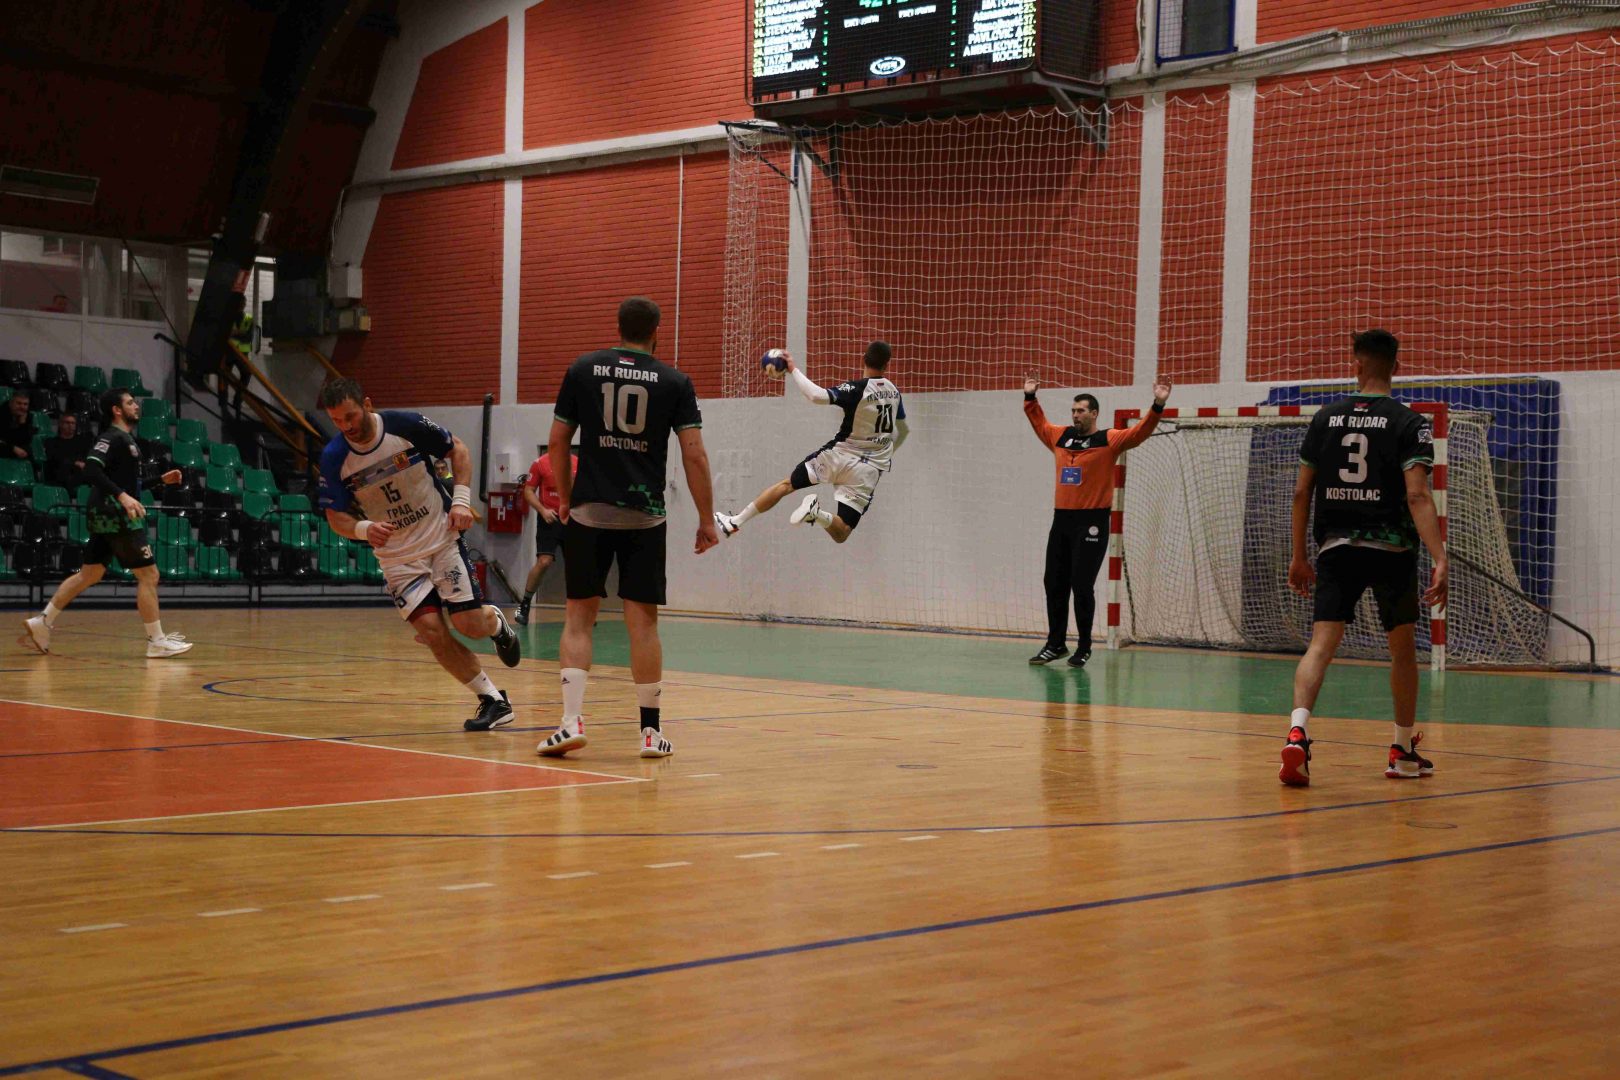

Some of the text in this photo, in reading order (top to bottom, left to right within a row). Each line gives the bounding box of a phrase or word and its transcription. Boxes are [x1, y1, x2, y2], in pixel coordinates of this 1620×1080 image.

[593, 365, 658, 383] RK RUDAR
[601, 382, 648, 434] 10
[875, 403, 893, 433] 10
[1328, 415, 1388, 429] RK RUDAR
[1338, 433, 1369, 484] 3
[380, 481, 402, 504] 15
[1326, 487, 1381, 501] KOSTOLAC
[386, 503, 413, 519] ГРАД
[497, 507, 506, 521] H
